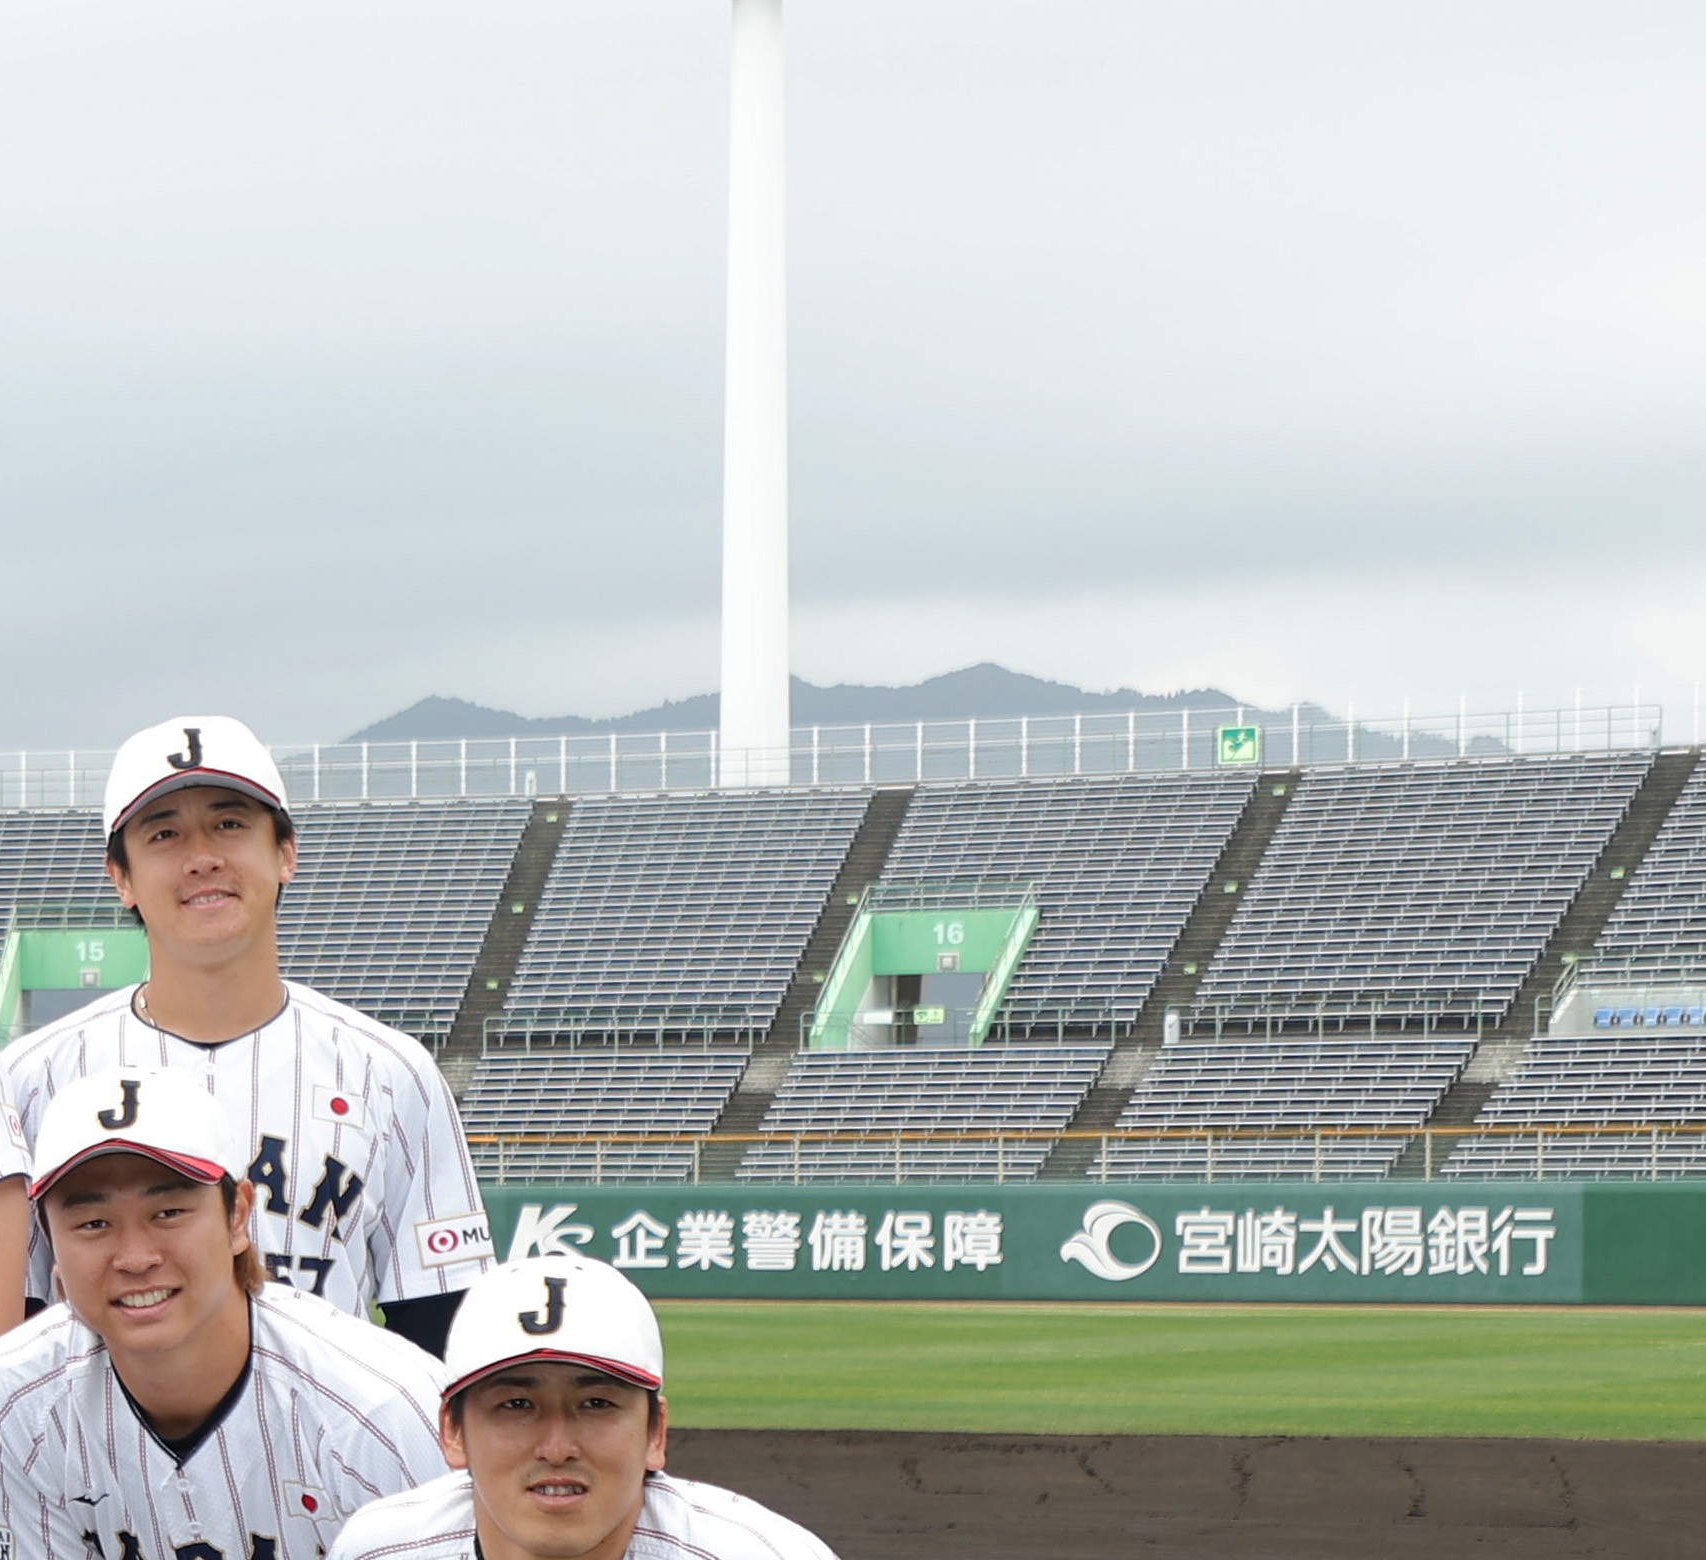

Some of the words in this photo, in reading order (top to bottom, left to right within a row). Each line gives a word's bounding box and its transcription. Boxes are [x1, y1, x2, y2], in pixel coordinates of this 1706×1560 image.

[166, 728, 203, 771] J
[75, 941, 105, 962] 15
[932, 923, 965, 945] 16
[97, 1080, 140, 1131] J
[462, 1226, 491, 1245] MU
[611, 1209, 1004, 1272] 企業警備保障
[1175, 1206, 1555, 1276] 宮崎太陽銀行
[518, 1276, 567, 1336] J
